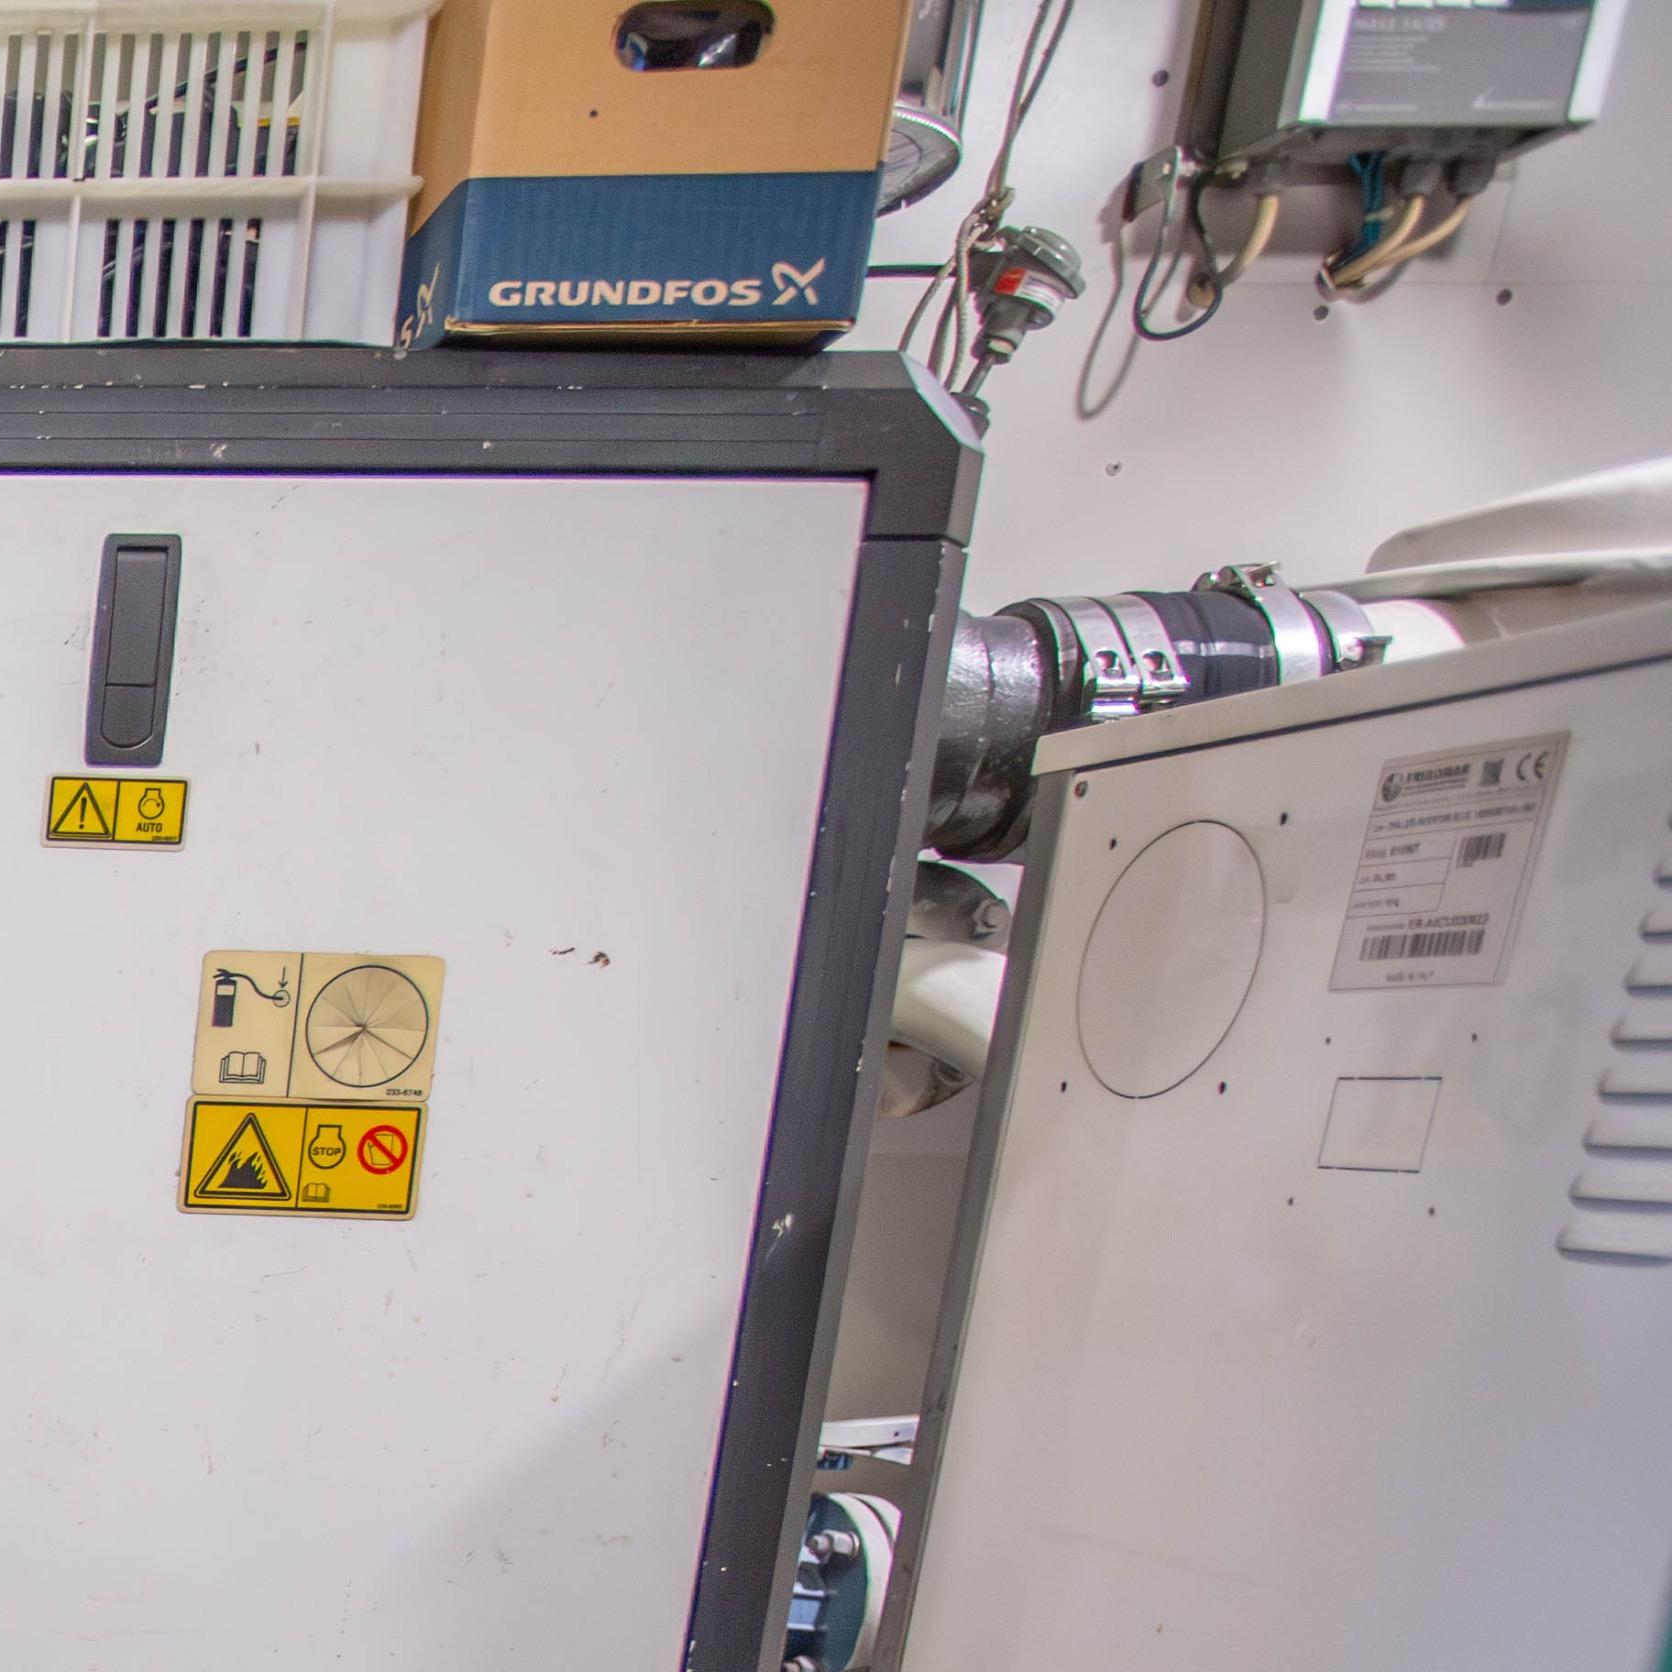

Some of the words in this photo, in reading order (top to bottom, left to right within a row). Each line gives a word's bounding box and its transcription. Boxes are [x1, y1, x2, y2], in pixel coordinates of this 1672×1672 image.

[488, 278, 762, 308] GRUNDFOS
[135, 822, 163, 833] AUTO
[312, 1146, 342, 1157] STOP
